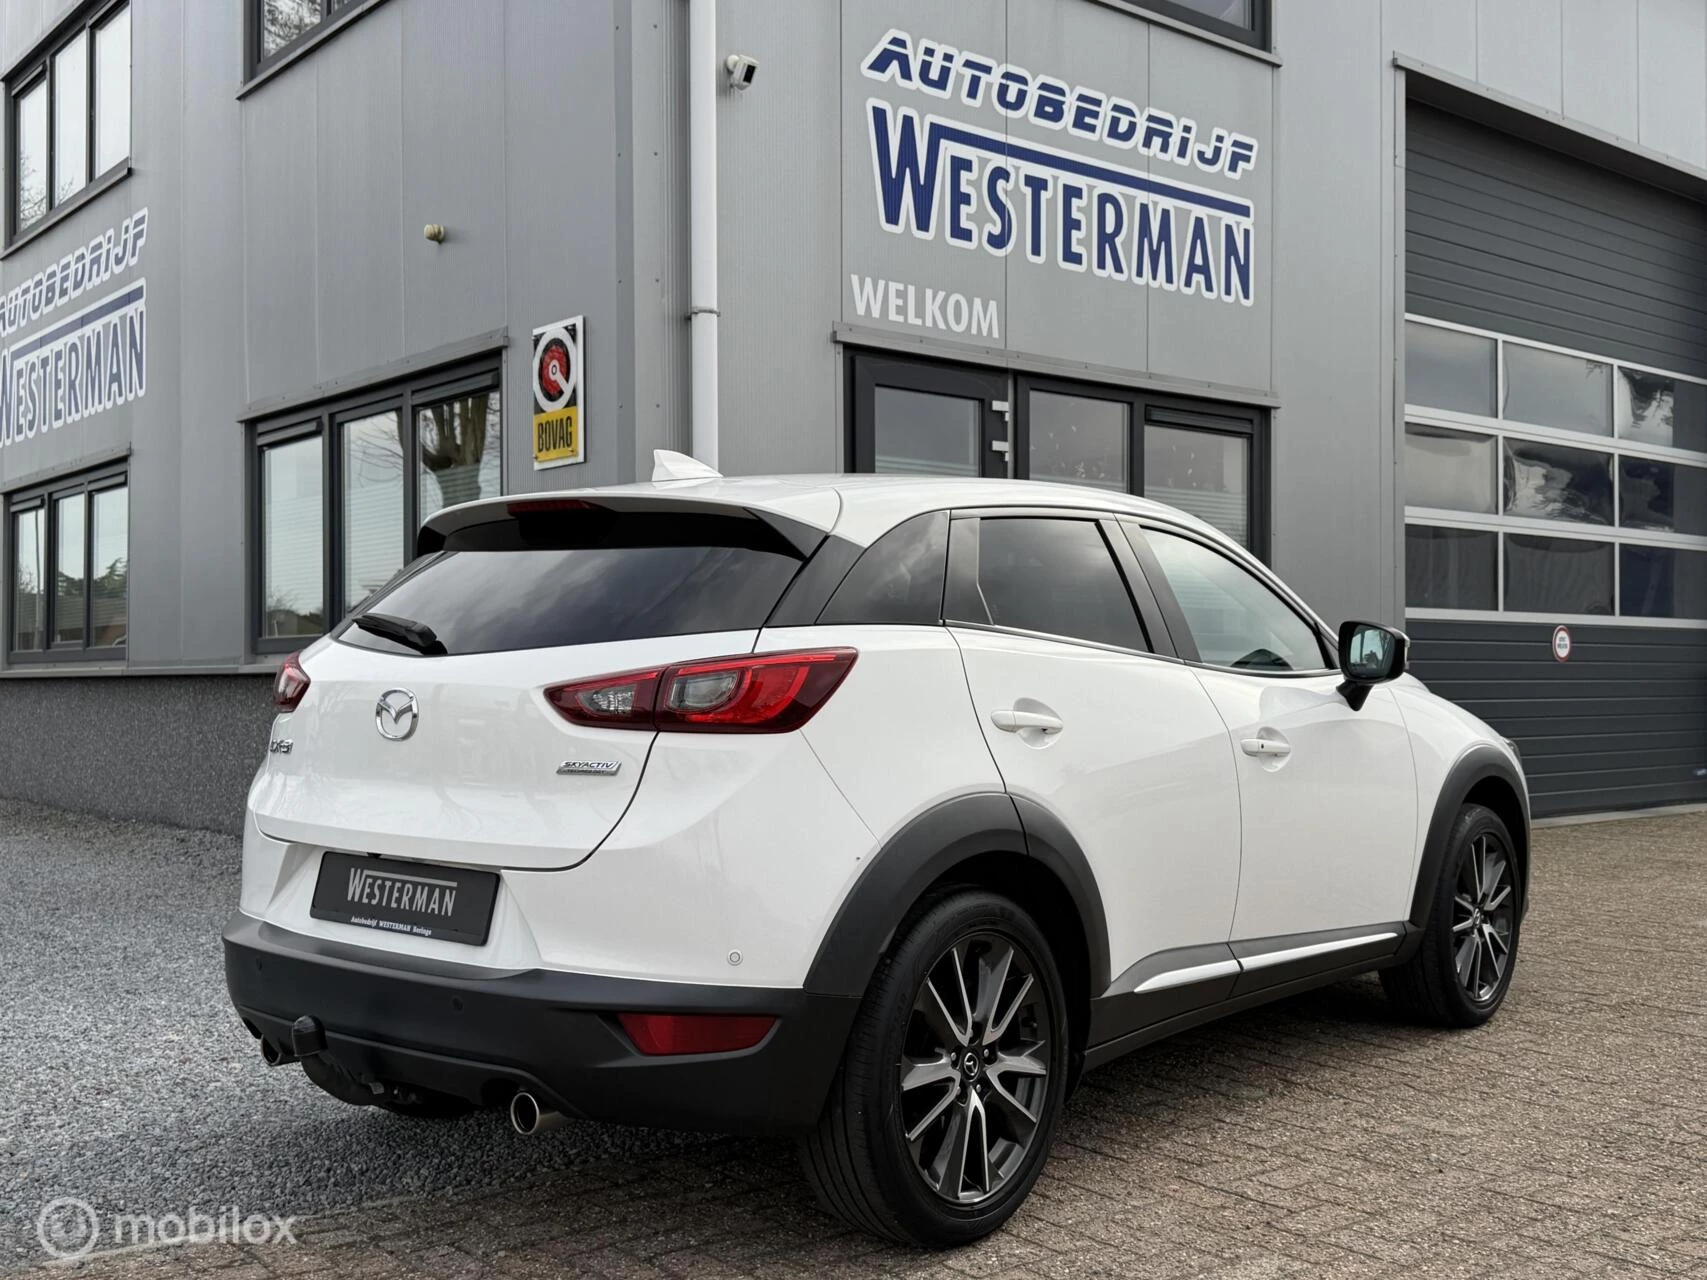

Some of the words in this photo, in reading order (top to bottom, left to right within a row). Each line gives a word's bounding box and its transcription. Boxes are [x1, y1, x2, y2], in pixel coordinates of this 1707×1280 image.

[861, 29, 1258, 179] AUTOBEDRIJF
[866, 98, 1254, 306] WESTERMAN
[850, 273, 1000, 339] WELKOM
[536, 415, 573, 453] BOVAG
[562, 761, 616, 769] SKYACTIV
[347, 867, 458, 917] WESTERMAN
[379, 920, 412, 932] WESTERMAN
